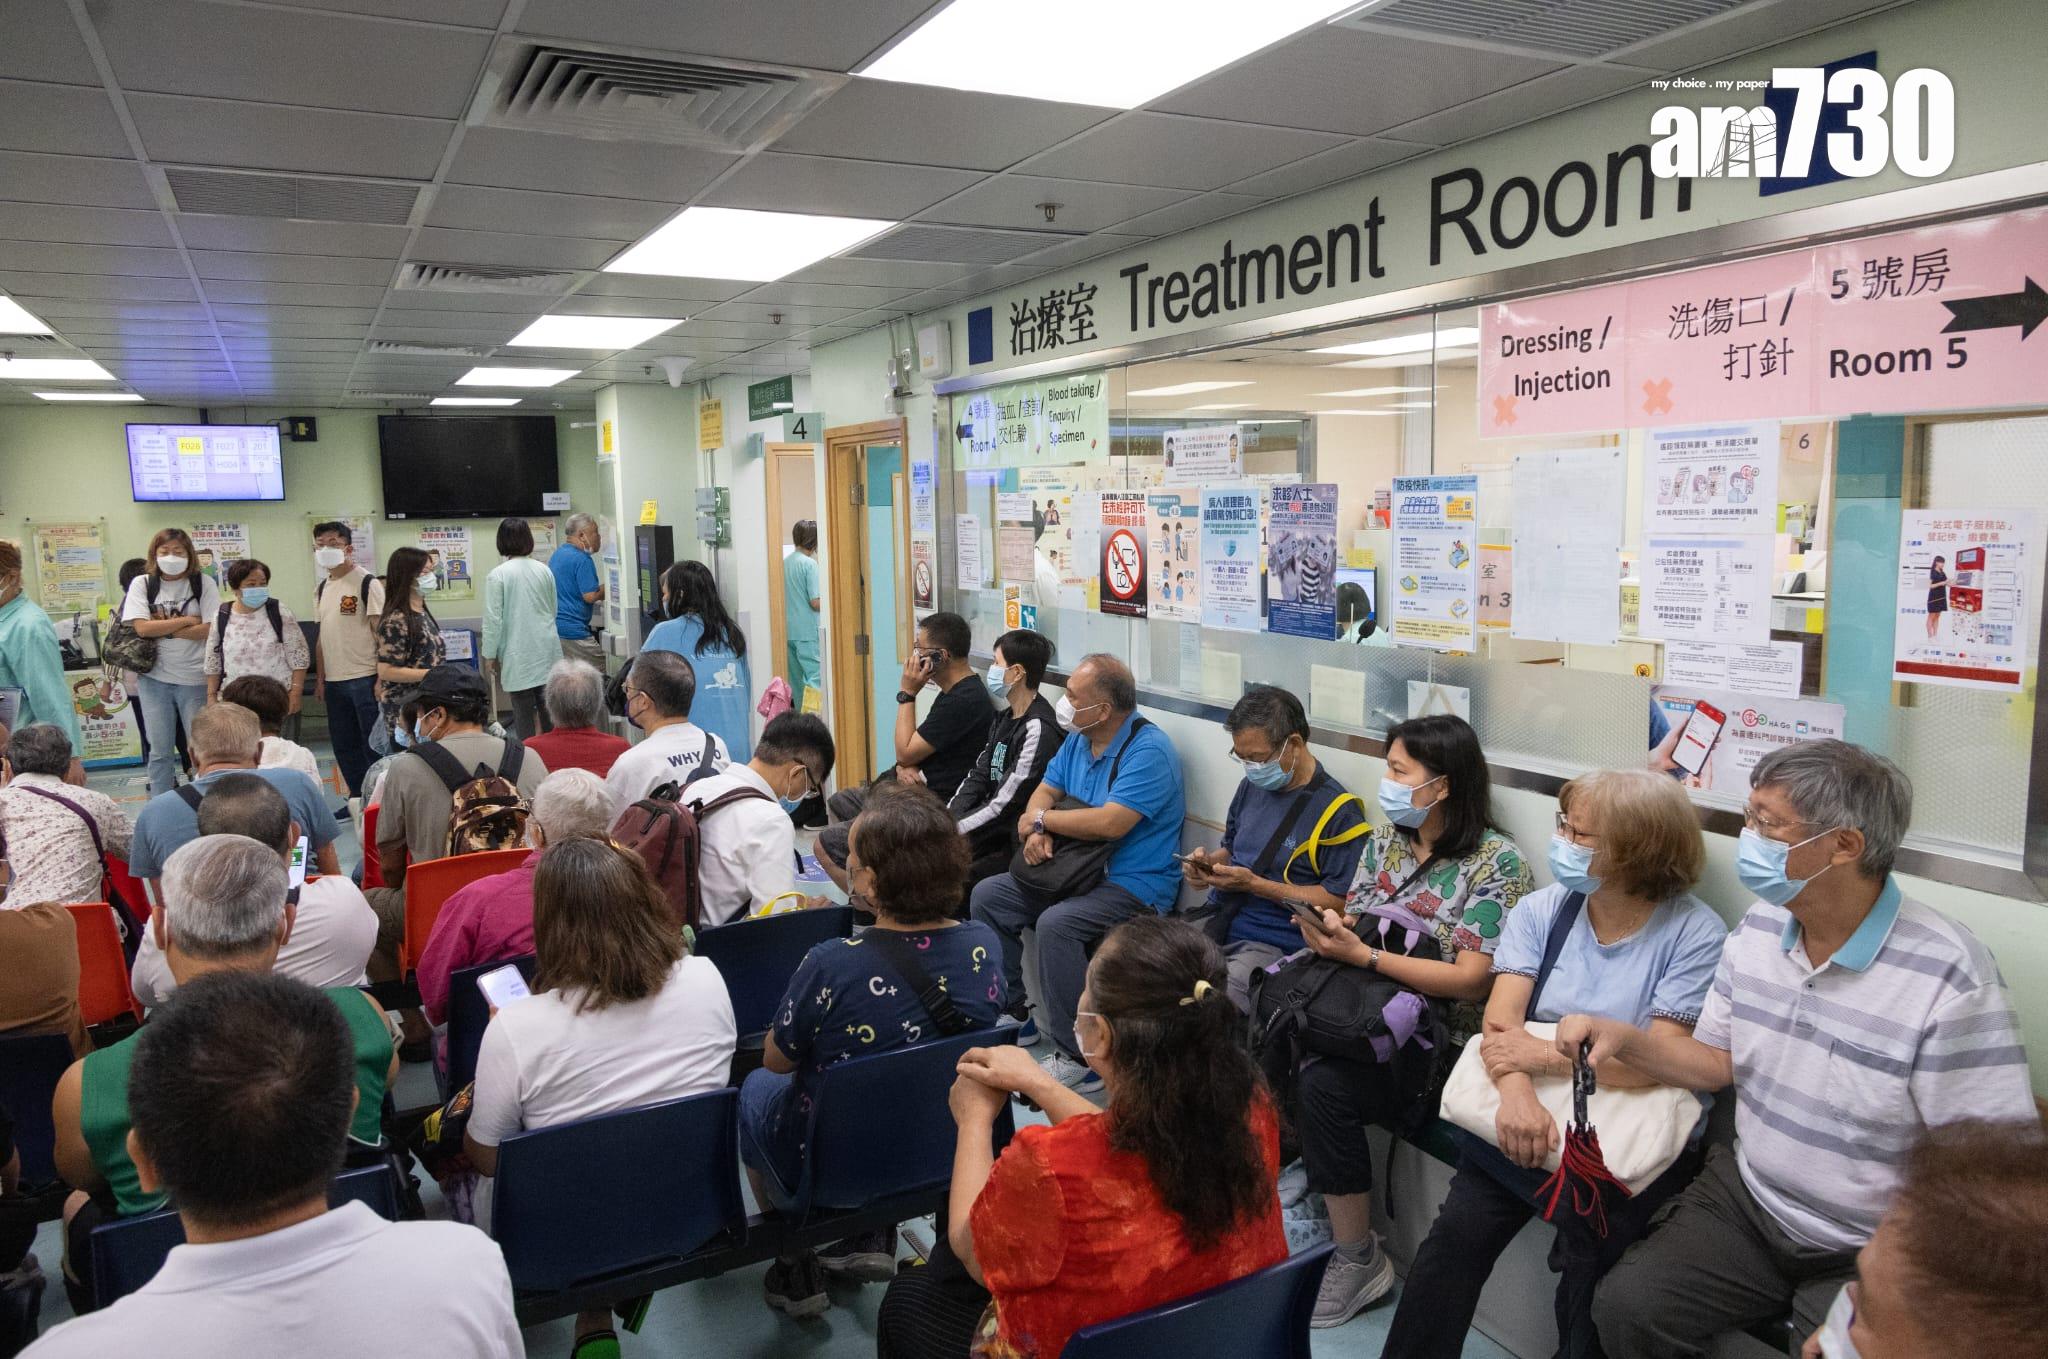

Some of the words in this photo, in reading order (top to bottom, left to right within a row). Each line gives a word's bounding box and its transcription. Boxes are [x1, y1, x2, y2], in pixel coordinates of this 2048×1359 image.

[1010, 281, 1098, 356] 治療室
[1120, 195, 1386, 332] Treatment
[1830, 268, 1849, 300] 5
[1861, 247, 1951, 301] 號房
[1668, 294, 1768, 341] 洗傷口
[1501, 325, 1592, 357] Dressing
[1723, 337, 1794, 381] 打針
[1830, 348, 1932, 379] Room
[1946, 337, 1968, 370] 5
[1049, 386, 1069, 401] Blood
[1070, 384, 1095, 400] taking
[1515, 366, 1611, 401] Injection
[1049, 407, 1076, 425] Enquiry
[792, 416, 807, 440] 4
[999, 424, 1027, 445] 交化驗
[970, 440, 990, 453] Room
[992, 437, 997, 450] 4
[1049, 429, 1085, 447] Specimen
[1798, 433, 1810, 450] 6
[1272, 487, 1312, 501] 求診人士
[1396, 479, 1430, 491] 防疫快訊
[1102, 502, 1146, 514] 在未經許可下
[1481, 562, 1498, 580] 室
[1499, 592, 1511, 608] 3
[1768, 720, 1778, 729] HA
[1780, 721, 1790, 729] Go
[667, 750, 701, 768] WHY
